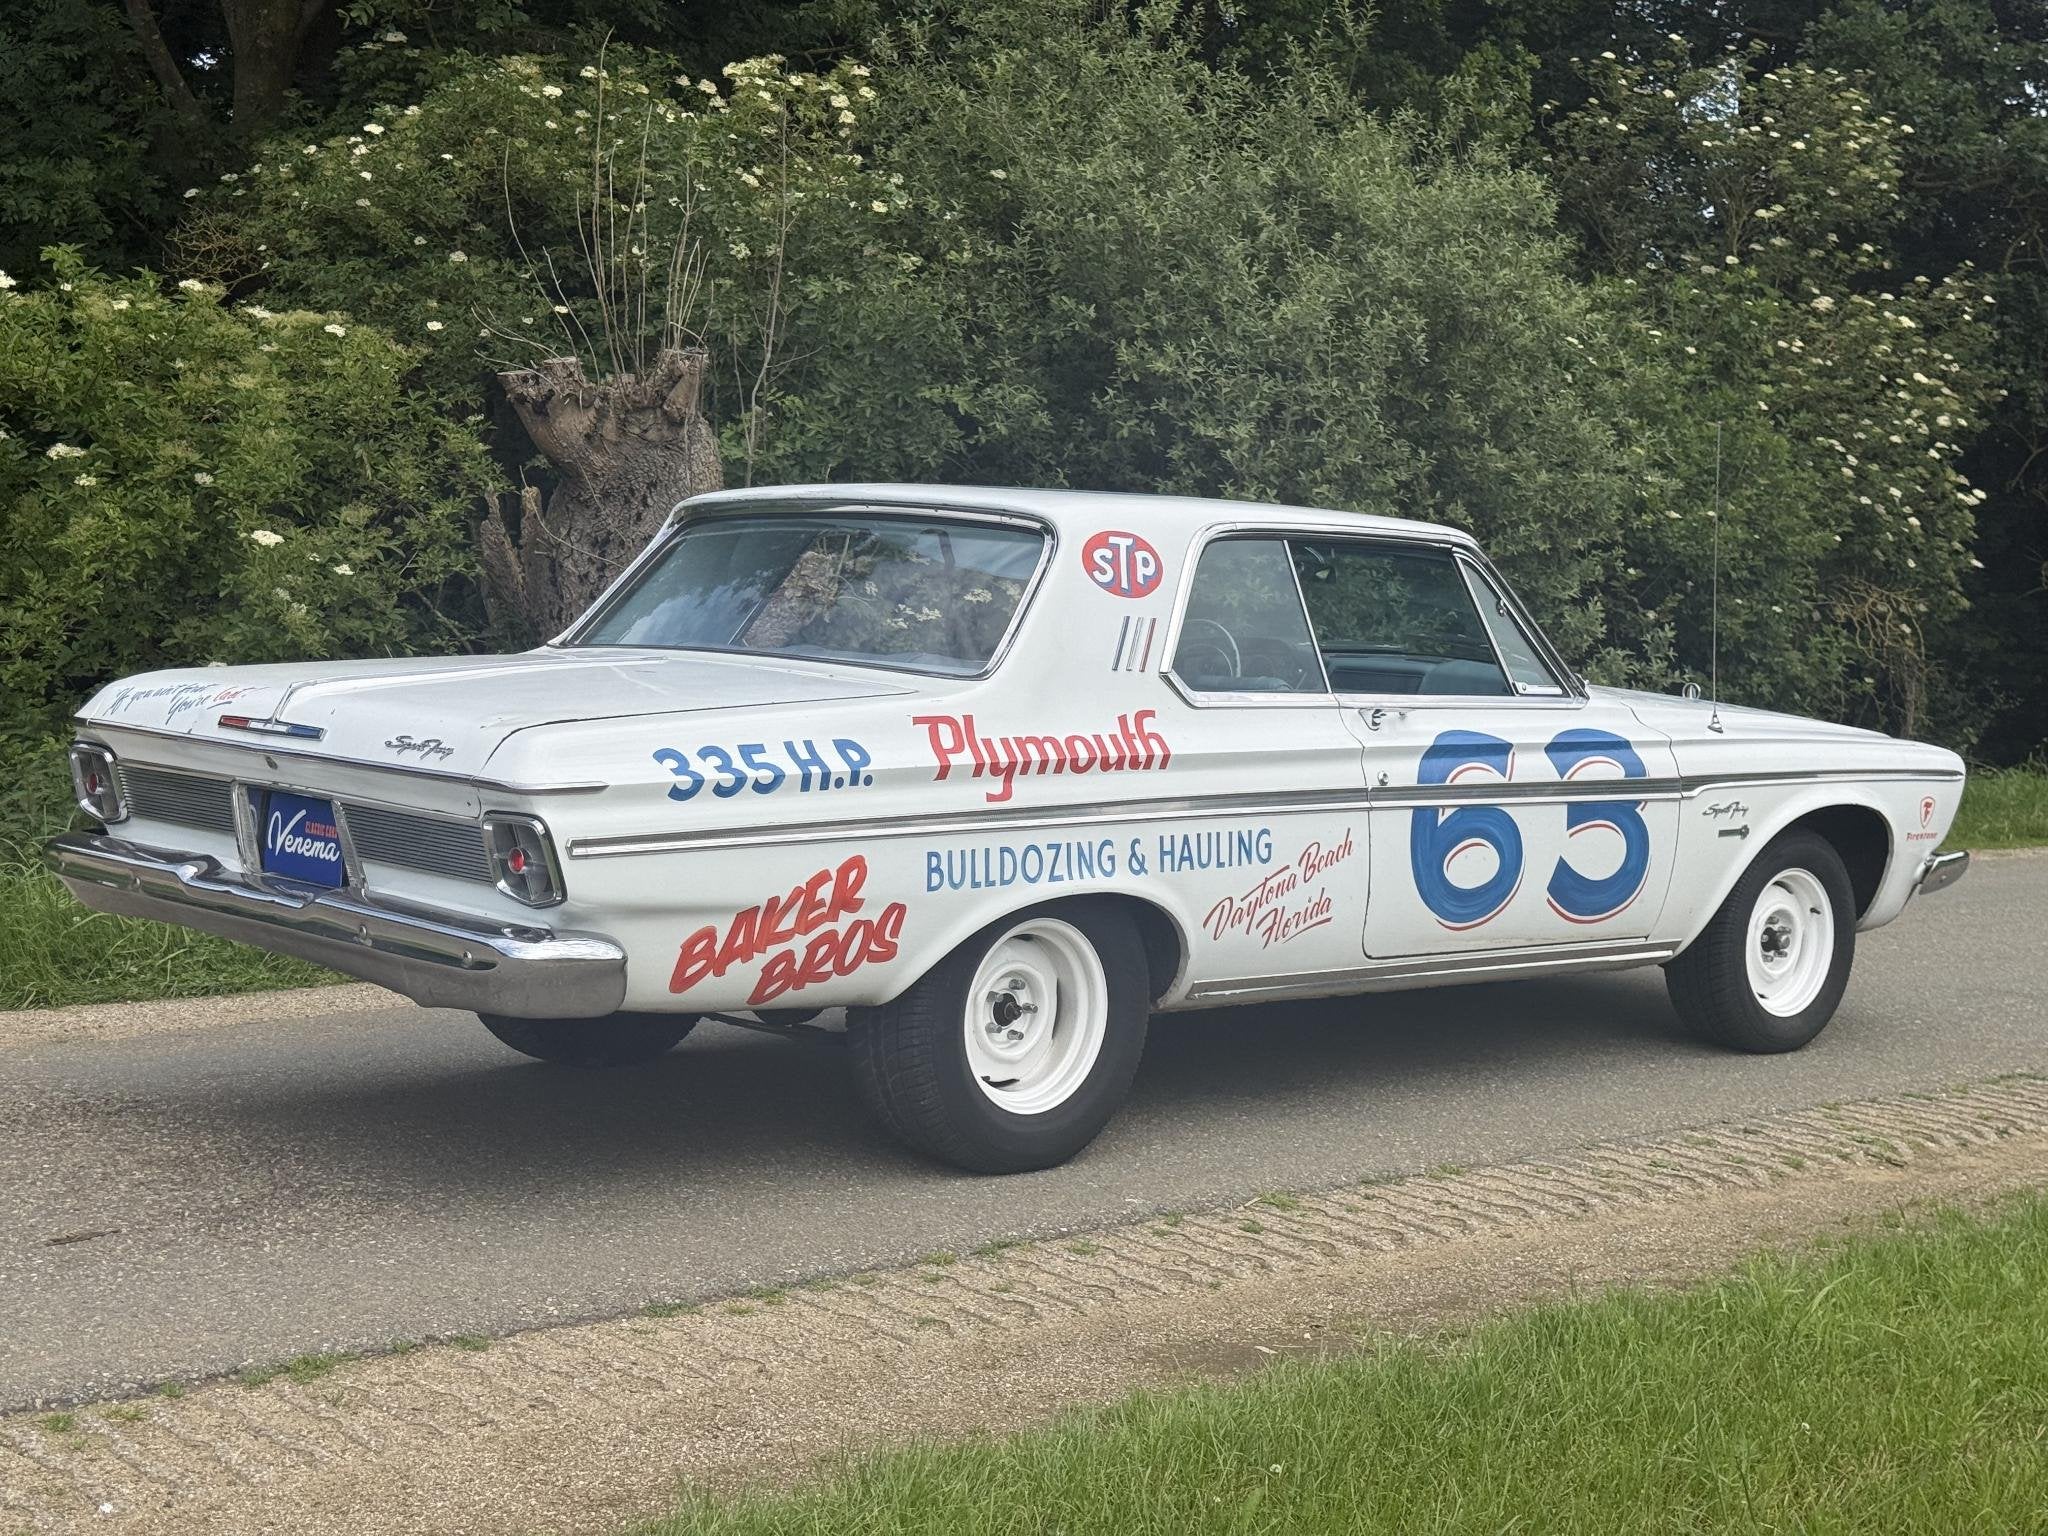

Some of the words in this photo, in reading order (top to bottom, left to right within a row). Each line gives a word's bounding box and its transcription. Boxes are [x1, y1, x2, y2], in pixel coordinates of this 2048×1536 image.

[1092, 536, 1157, 590] STP
[652, 744, 786, 802] 335
[783, 738, 874, 792] H.P.
[912, 709, 1171, 803] Plymouth
[268, 809, 340, 862] Venema
[926, 839, 1117, 892] BULLDOZING
[1128, 838, 1149, 876] &
[1159, 828, 1273, 873] HAULING
[1410, 728, 1652, 931] 63
[1202, 864, 1291, 941] Daytona
[1298, 827, 1353, 884] Beach
[1255, 887, 1333, 950] Florida
[669, 854, 868, 994] BAKER
[746, 902, 907, 1006] BROS
